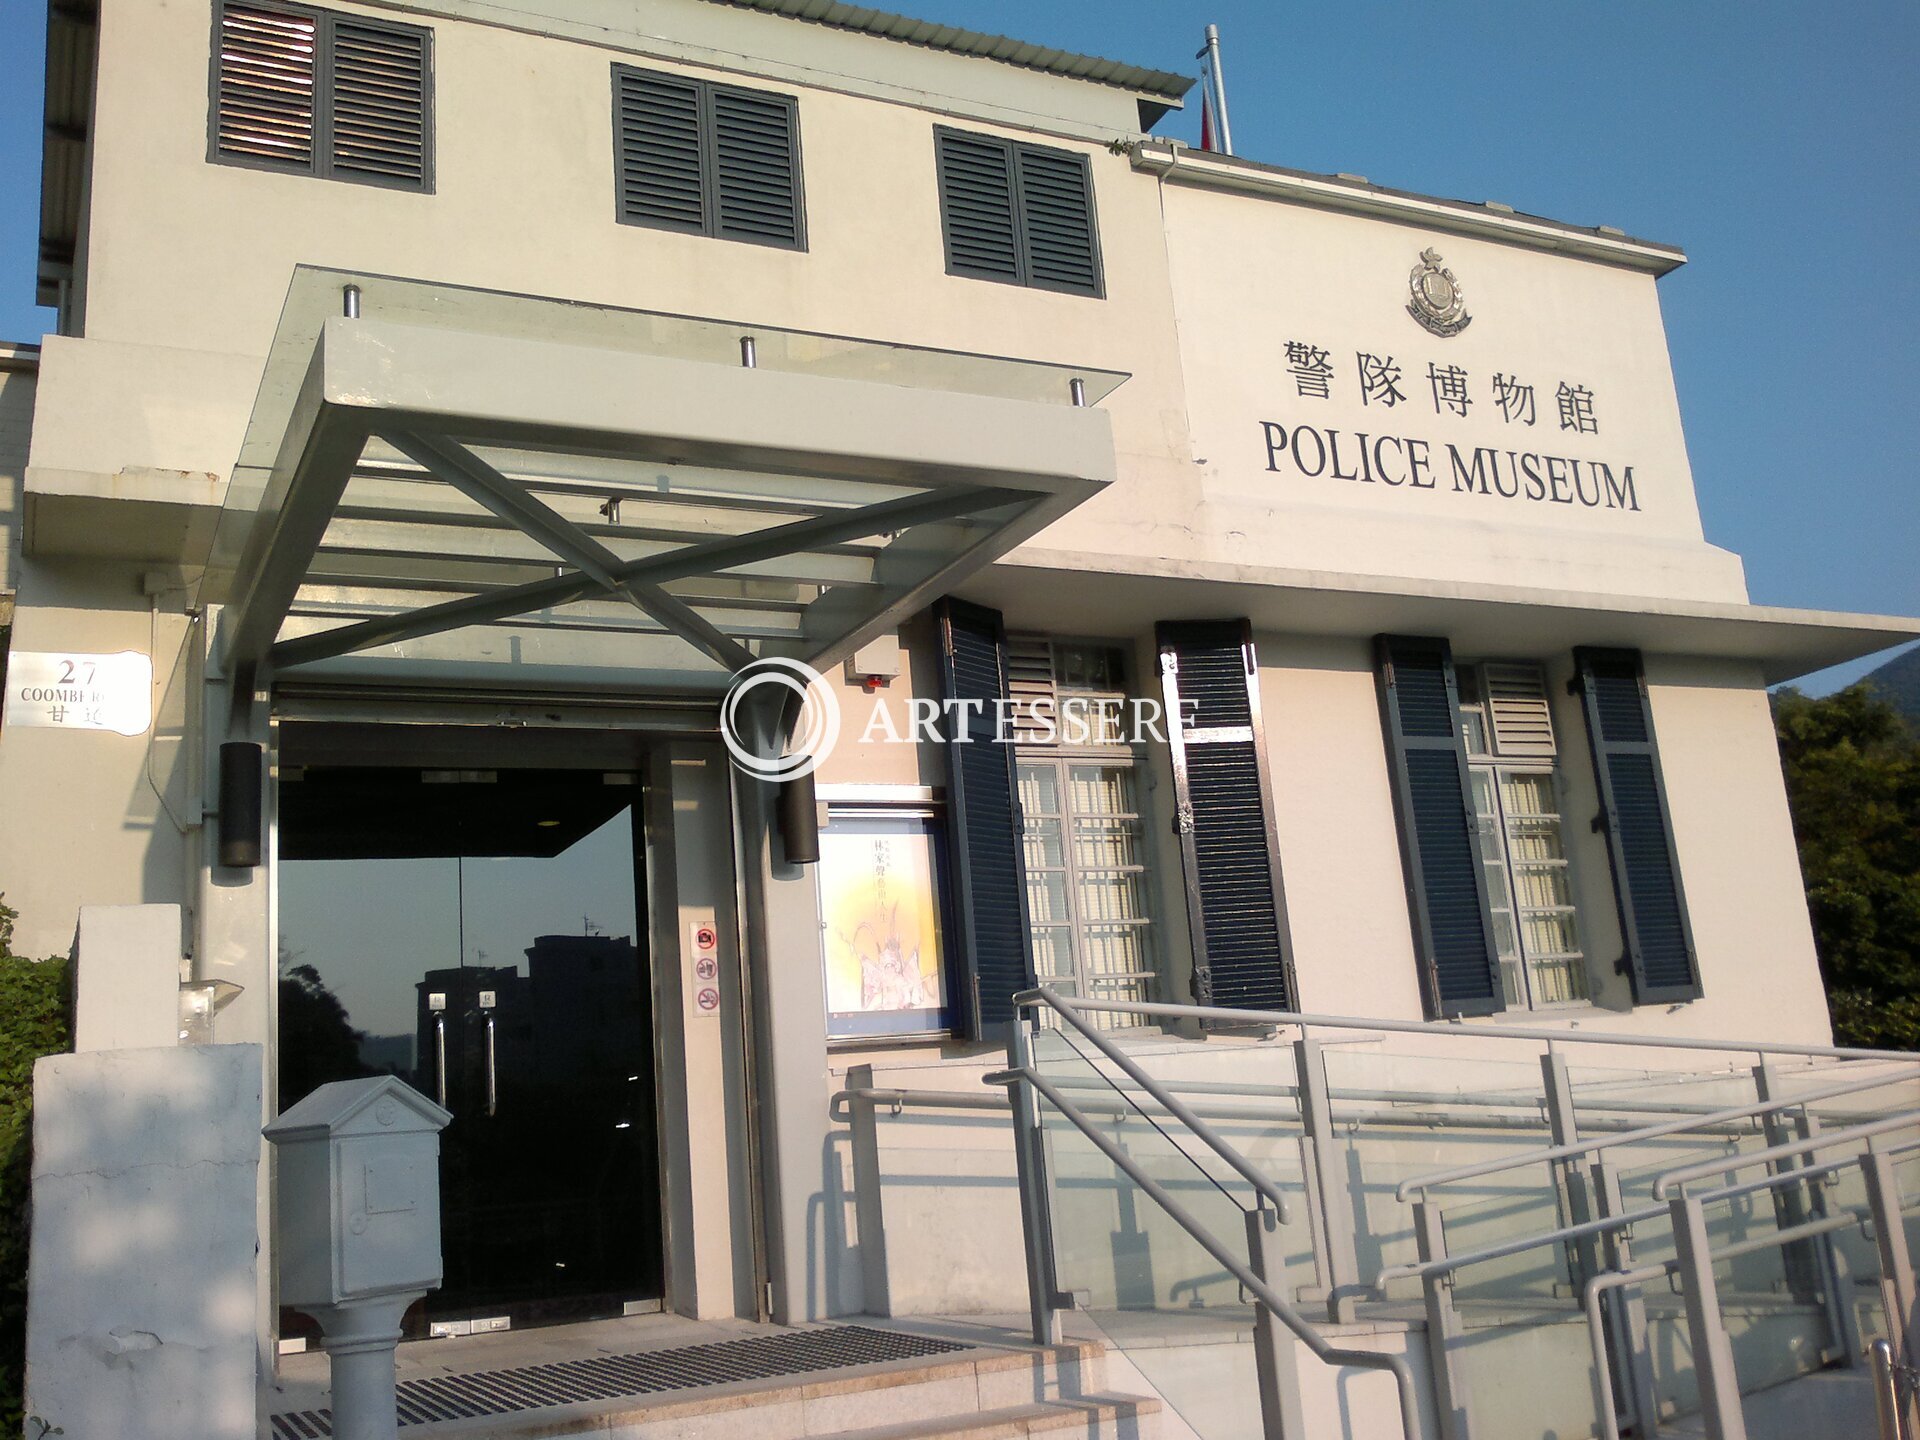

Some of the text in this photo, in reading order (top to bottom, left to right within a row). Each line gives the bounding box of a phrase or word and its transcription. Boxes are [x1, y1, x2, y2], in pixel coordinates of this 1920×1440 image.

[1284, 341, 1599, 435] 警隊博物館
[1259, 421, 1642, 511] POLICE MUSEUM
[58, 659, 97, 685] 27
[47, 704, 104, 725] 甘
